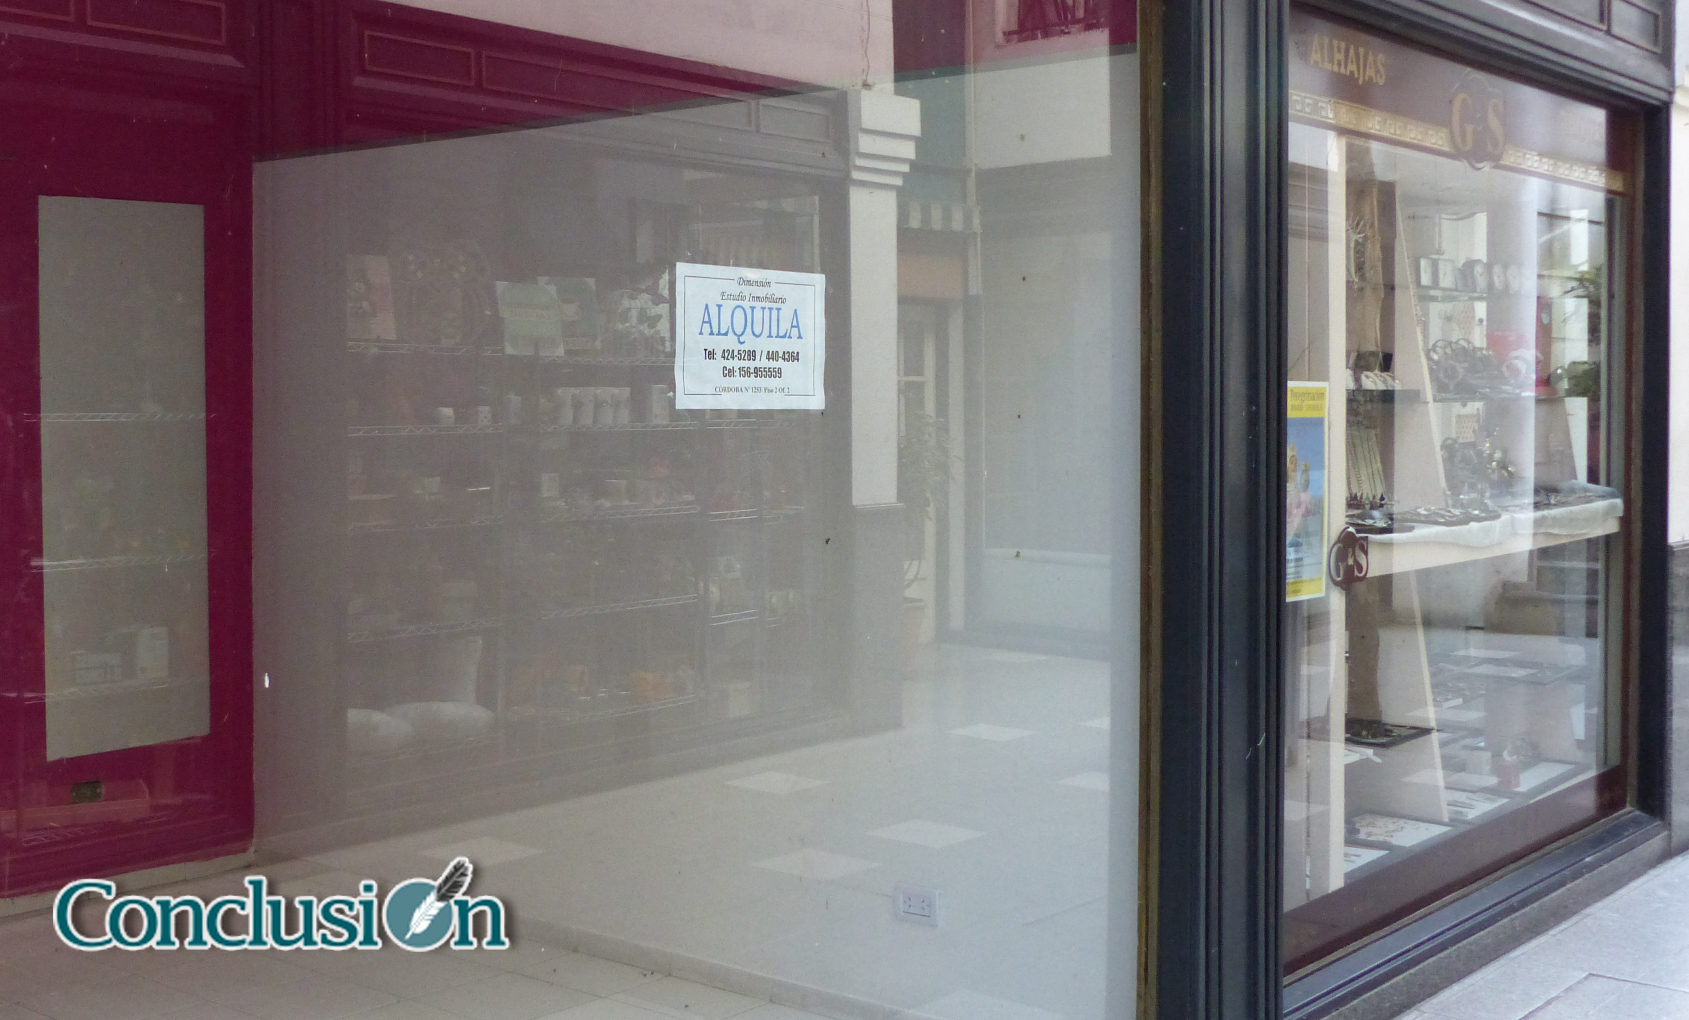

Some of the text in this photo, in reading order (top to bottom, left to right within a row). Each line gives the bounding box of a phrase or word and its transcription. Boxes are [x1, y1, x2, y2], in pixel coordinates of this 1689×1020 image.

[1310, 34, 1387, 86] ALHAJAS
[736, 276, 772, 288] Dimensión
[720, 291, 787, 304] Estudio Inmobiliario
[698, 303, 803, 345] ALQUILA
[703, 348, 717, 361] Tel:
[721, 349, 757, 362] 424-5289
[765, 350, 800, 363] 440-4364
